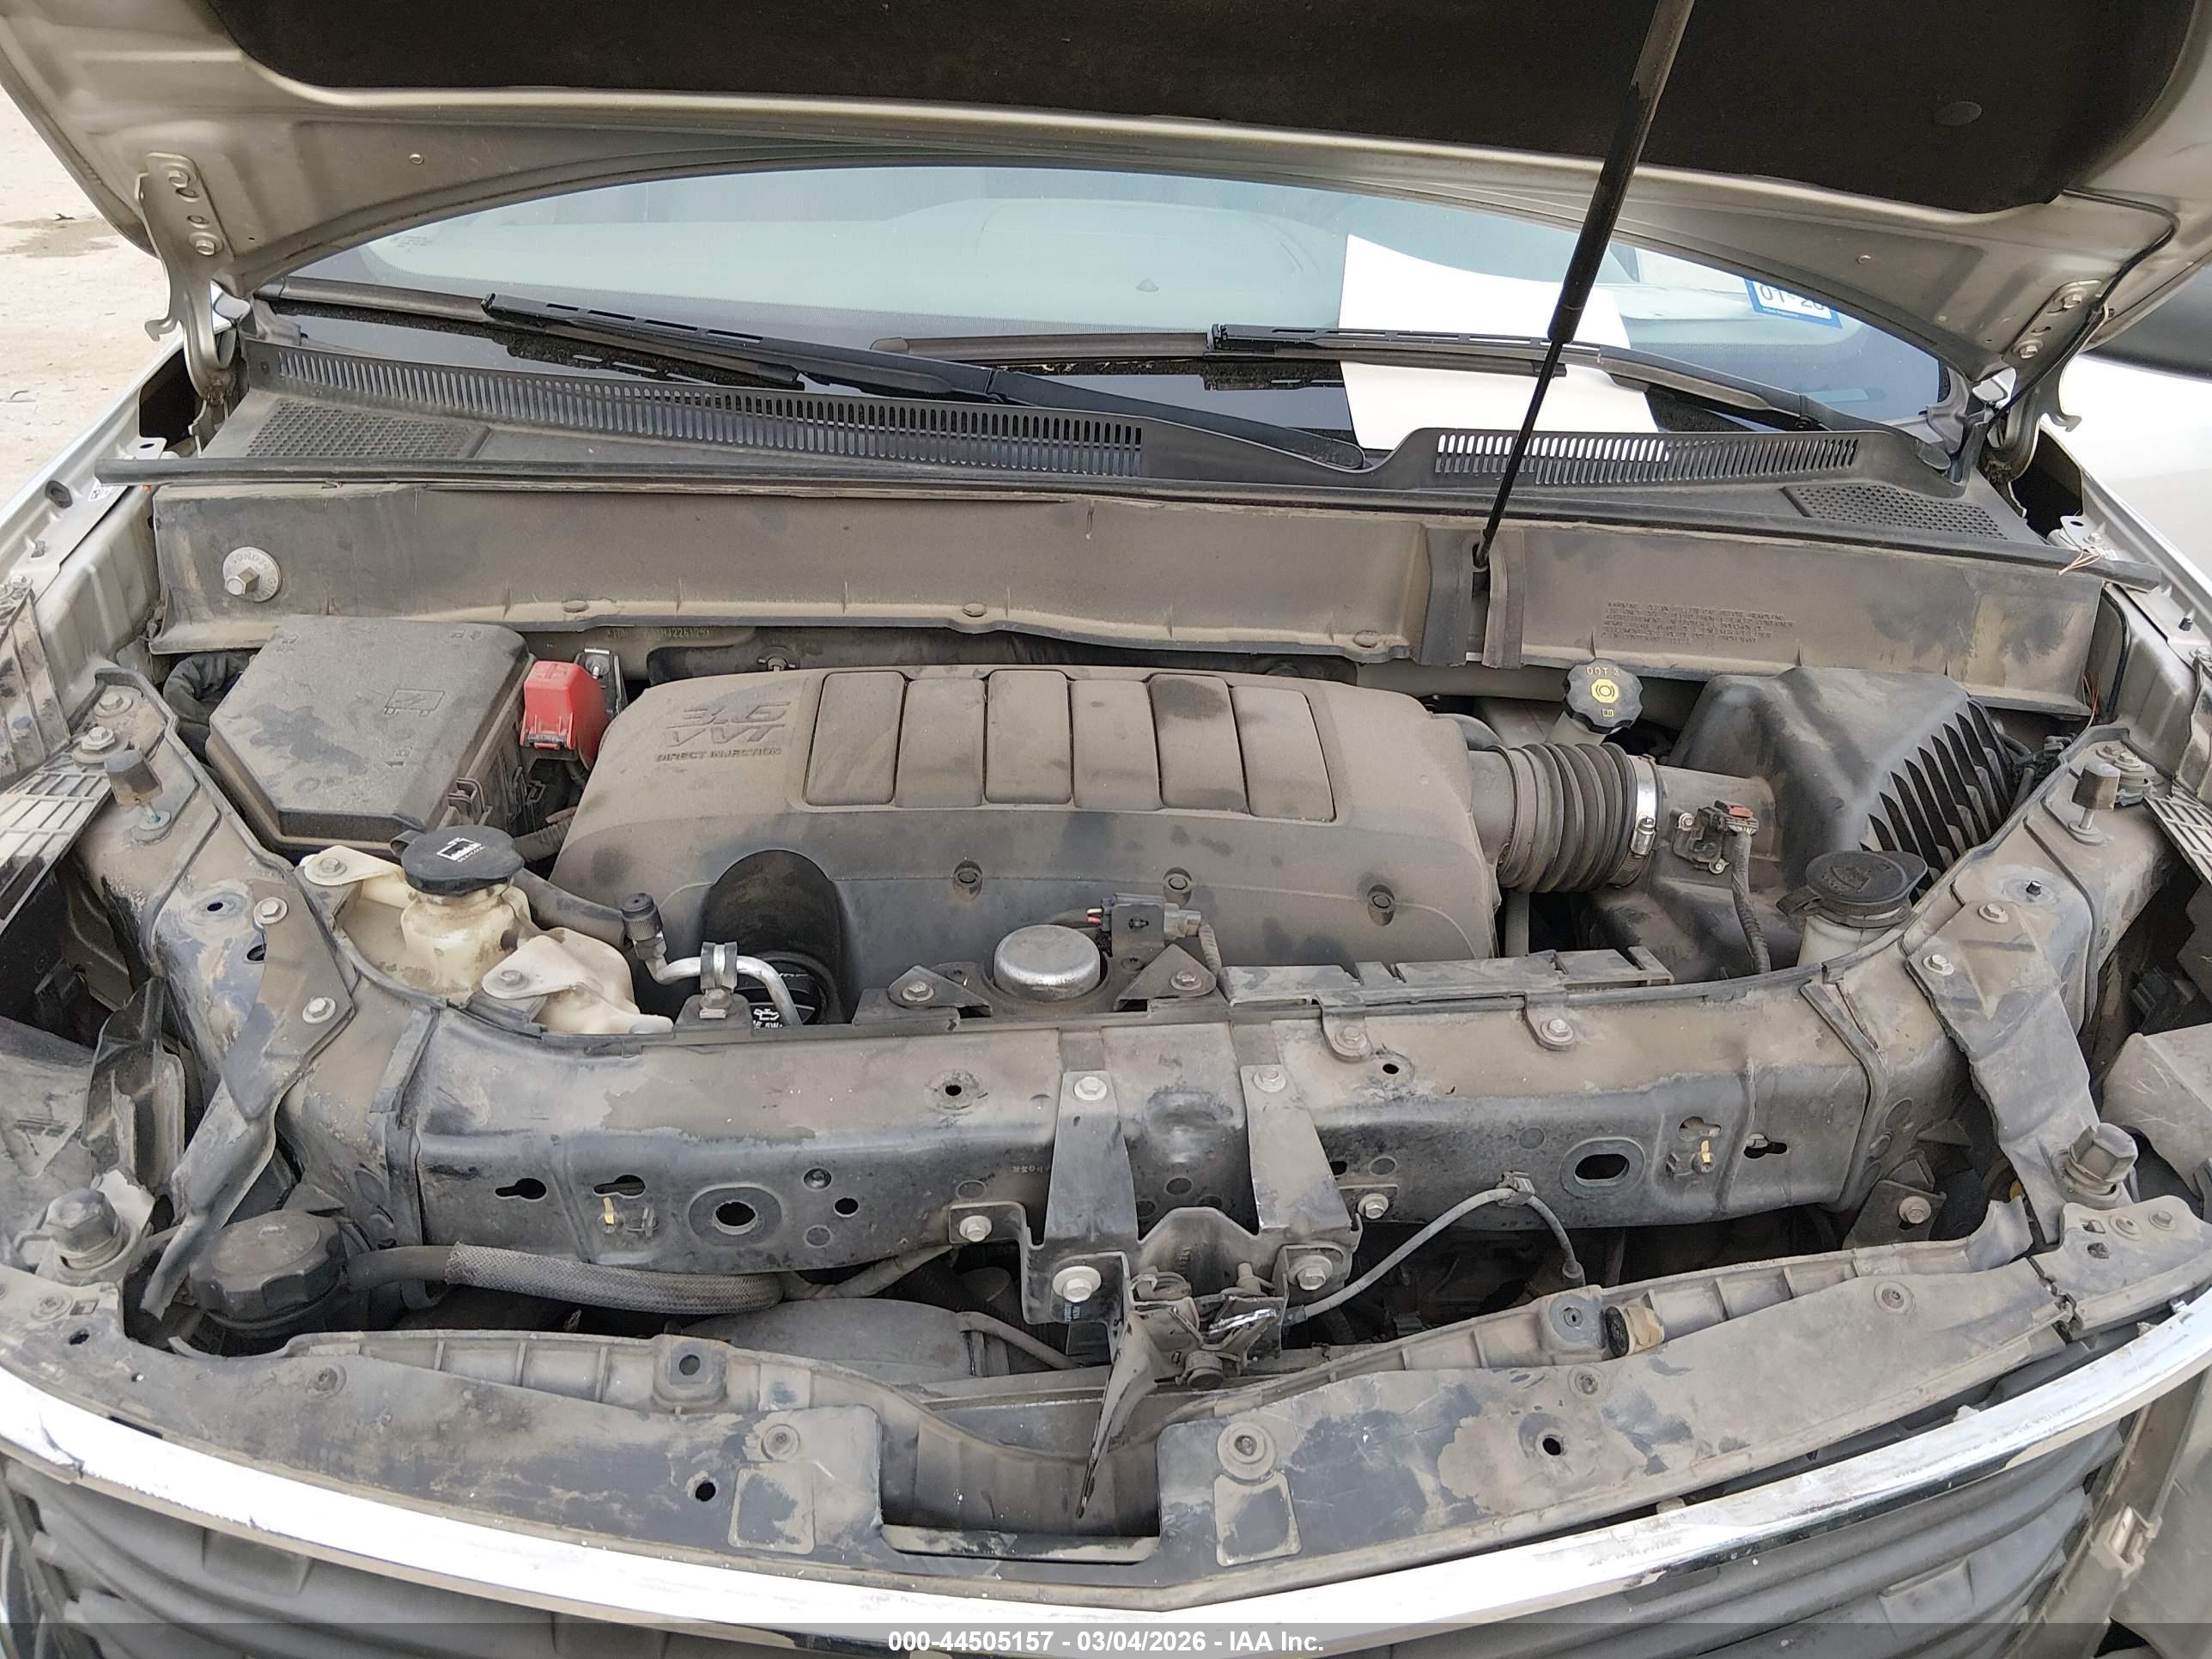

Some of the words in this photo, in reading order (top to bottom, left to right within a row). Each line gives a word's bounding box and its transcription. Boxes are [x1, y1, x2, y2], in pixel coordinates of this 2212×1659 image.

[1586, 666, 1608, 676] DOT
[1613, 666, 1620, 677] 3
[667, 702, 790, 726] 3.6
[665, 725, 785, 747] VVT
[656, 750, 708, 763] DIRECT
[710, 747, 782, 759] INJECTION
